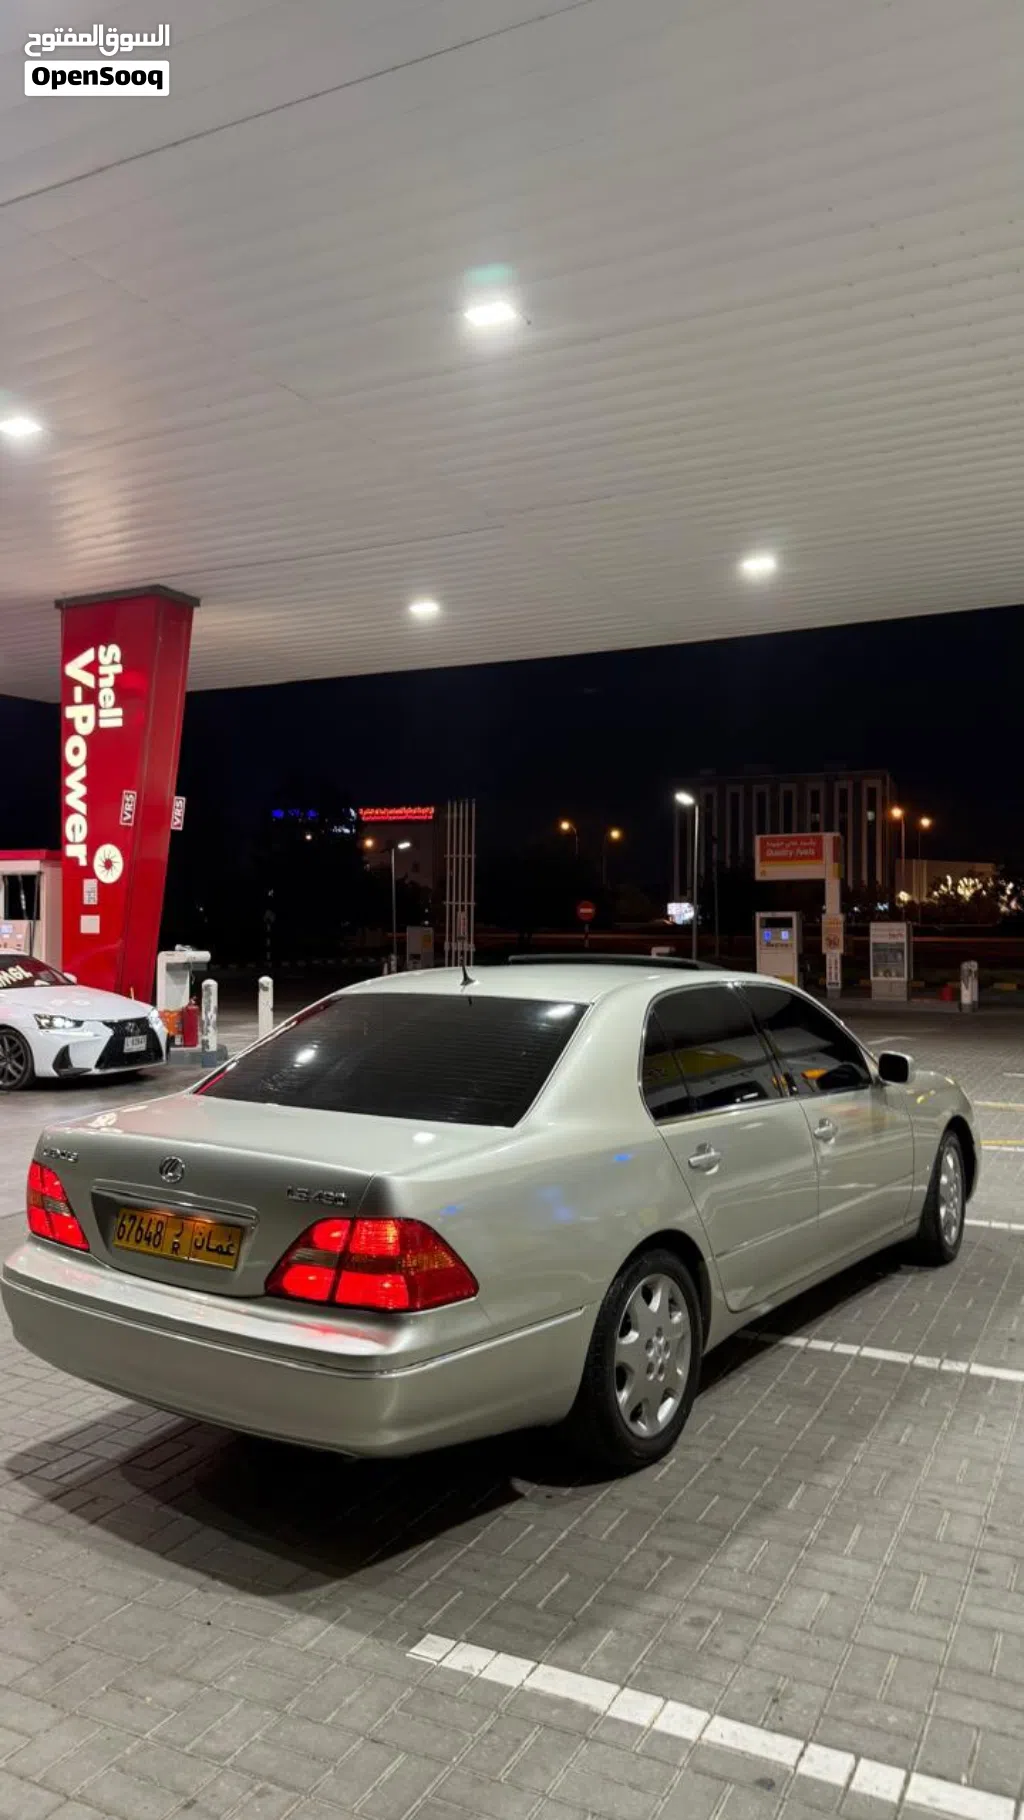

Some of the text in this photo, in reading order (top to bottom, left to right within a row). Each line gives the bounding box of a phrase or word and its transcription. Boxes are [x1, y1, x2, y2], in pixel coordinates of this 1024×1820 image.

[98, 644, 123, 728] Shell
[65, 647, 96, 866] V-Power
[123, 793, 136, 821] VRS
[116, 1213, 165, 1249] 67648
[172, 1241, 181, 1255] R
